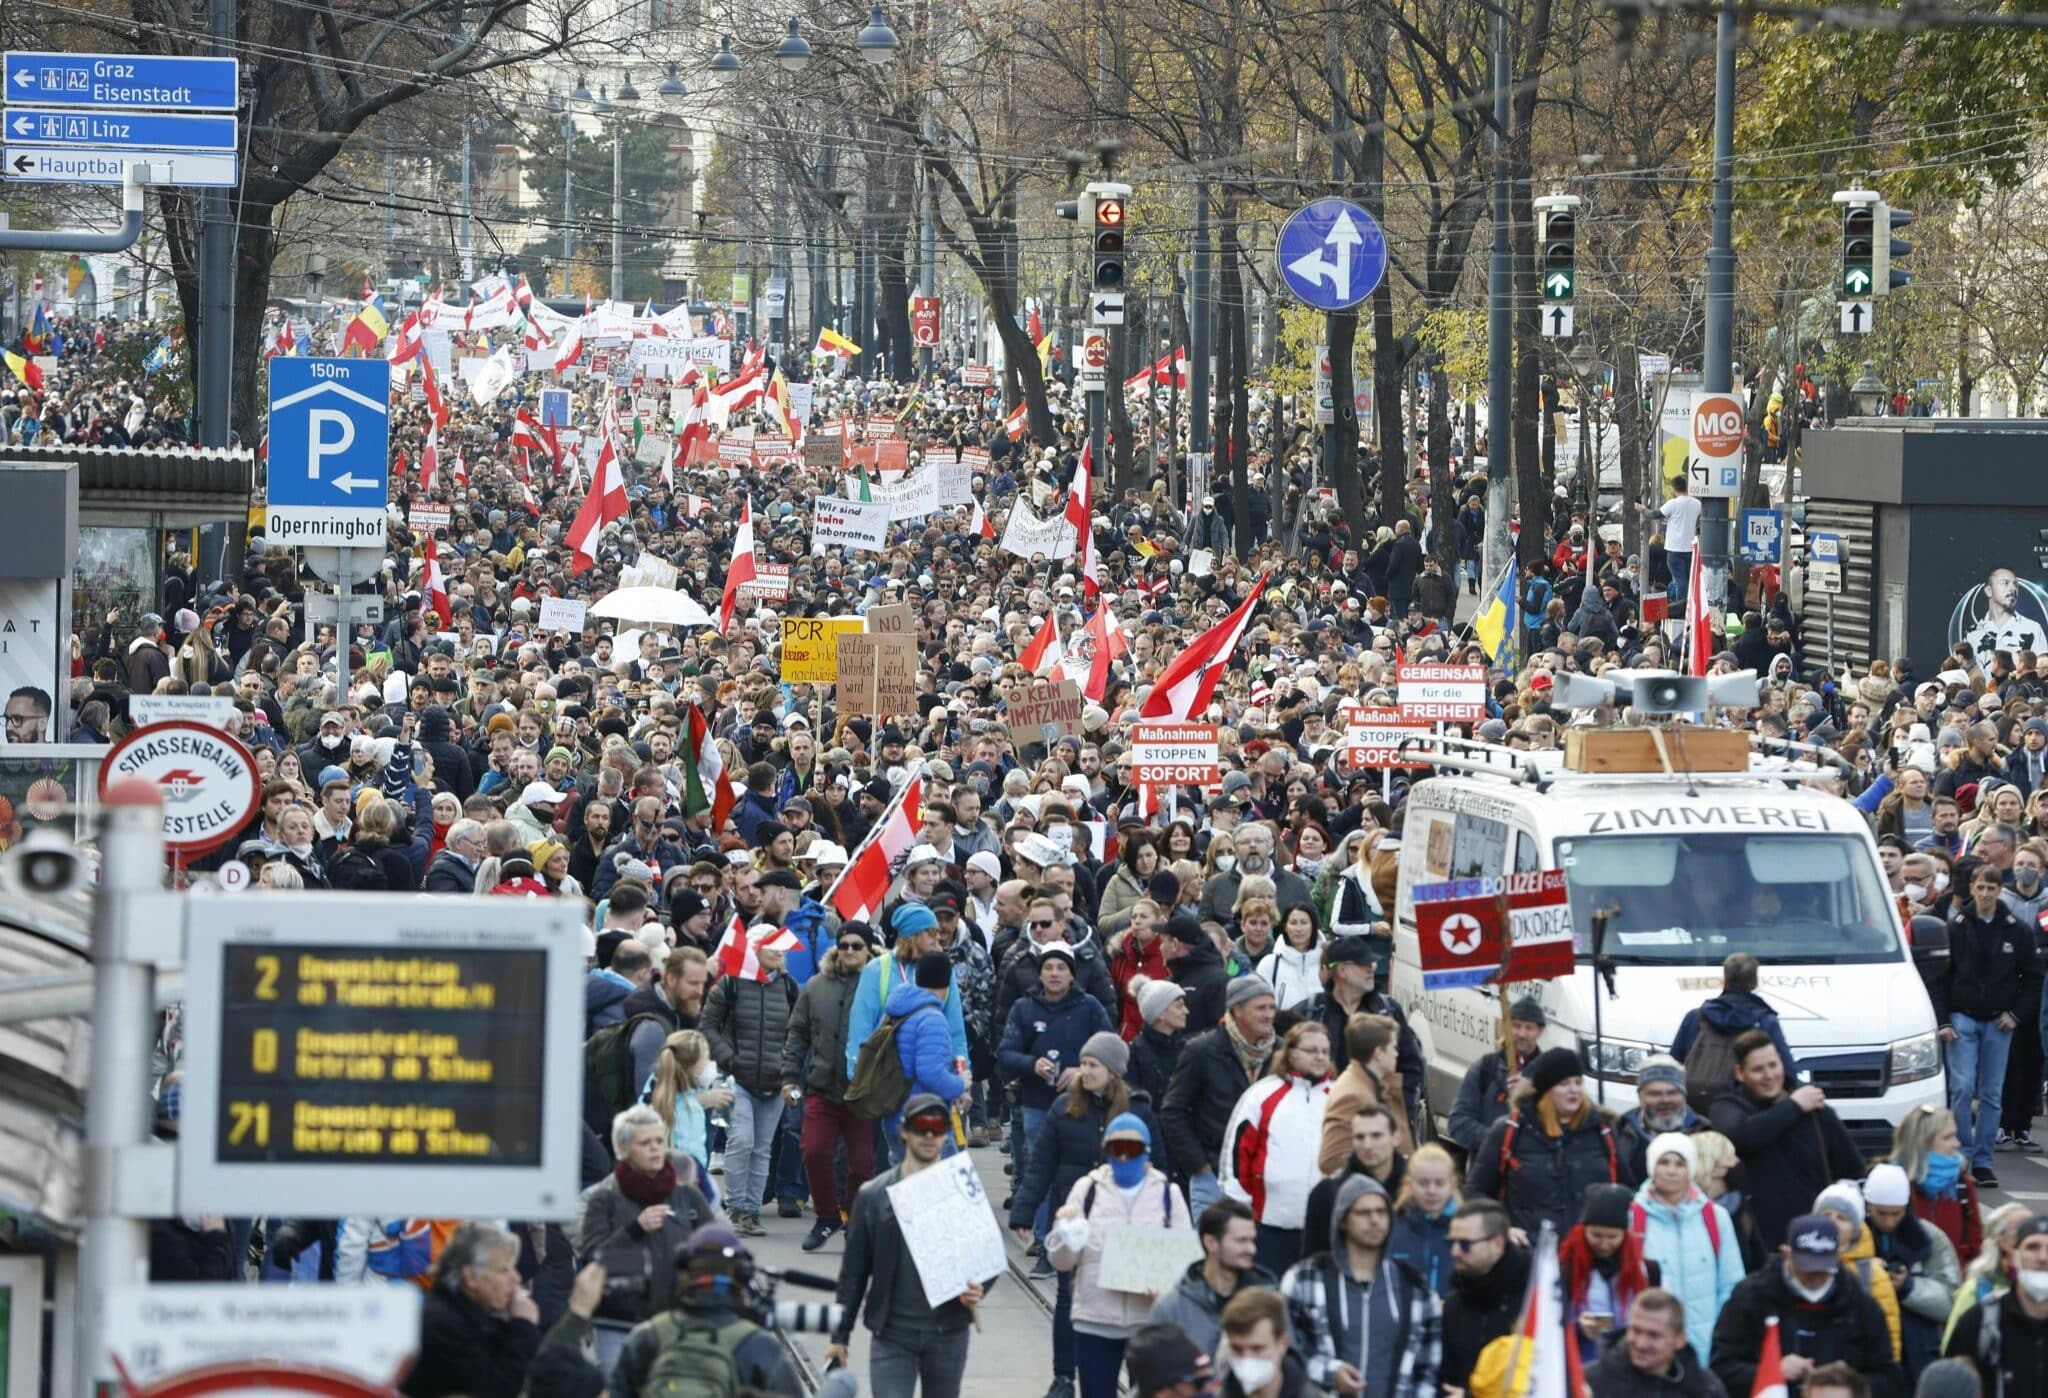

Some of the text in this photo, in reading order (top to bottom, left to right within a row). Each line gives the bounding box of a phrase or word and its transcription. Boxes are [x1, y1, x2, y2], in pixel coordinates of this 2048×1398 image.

[69, 61, 134, 88] A2 Graz
[94, 84, 191, 103] Eisenstadt
[69, 120, 130, 138] A1 Linz
[310, 363, 349, 378] 150m
[1697, 411, 1742, 436] MQ
[308, 409, 355, 479] P
[1725, 471, 1735, 484] P
[410, 503, 434, 511] HÄNDE
[818, 502, 862, 516] Wir sind
[271, 515, 383, 536] Opernringhof
[817, 514, 844, 525] keine
[815, 526, 876, 542] Laborratten
[770, 565, 788, 574] WEG
[784, 620, 823, 640] PCR
[880, 615, 901, 632] NO
[783, 645, 809, 661] keine
[1400, 667, 1483, 680] GEMEINSAM
[845, 679, 863, 694] wird
[1027, 683, 1061, 703] KEIN
[1422, 687, 1462, 698] für die
[846, 701, 863, 712] zur
[1403, 704, 1482, 718] FREIHEIT
[1139, 728, 1212, 741] Maßnahmen
[119, 737, 244, 780] STRASSENBAHN
[1144, 749, 1206, 760] STOPPEN
[1140, 766, 1212, 781] SOFORT
[1584, 807, 1830, 834] ZIMMEREI
[227, 869, 241, 884] D
[1482, 872, 1543, 896] POLIZEI
[255, 956, 280, 999] 2
[229, 1102, 270, 1147] 71
